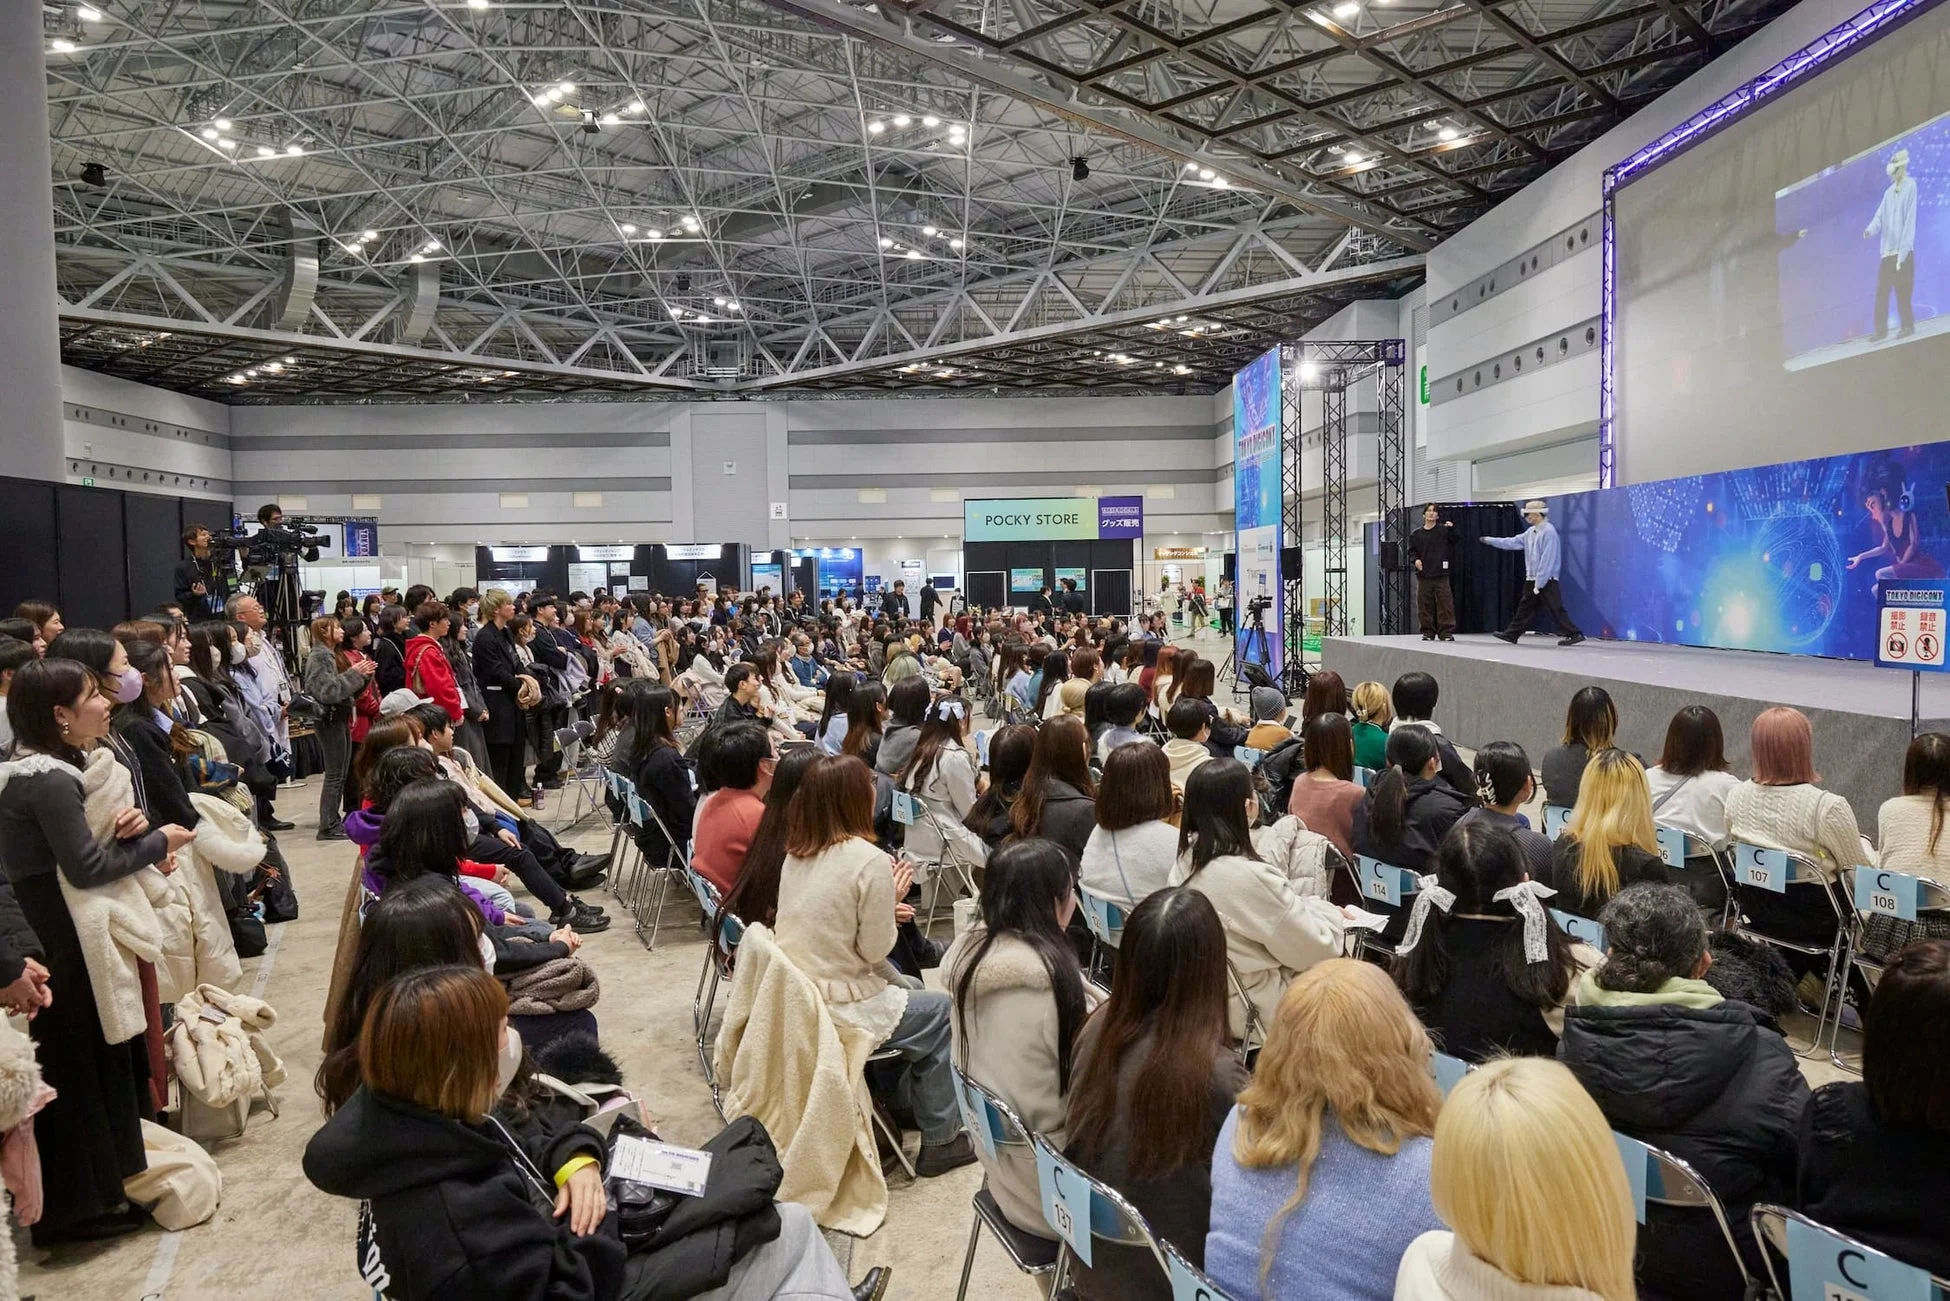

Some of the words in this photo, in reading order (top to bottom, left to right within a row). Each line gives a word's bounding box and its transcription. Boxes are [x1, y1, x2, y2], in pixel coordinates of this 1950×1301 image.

[985, 514, 1031, 526] POCKY
[1036, 513, 1079, 525] STORE
[1102, 519, 1139, 528] グッズ販売
[1887, 591, 1909, 600] TOKYO
[1910, 591, 1943, 601] DIGICONX
[1891, 611, 1906, 621] 撮影
[1920, 612, 1936, 622] 録音
[1890, 621, 1906, 631] 禁止
[1920, 622, 1936, 632] 禁止
[1656, 829, 1664, 843] C
[1754, 849, 1765, 866] C
[1374, 862, 1383, 879] C
[1750, 870, 1768, 882] 107
[1877, 873, 1890, 891] C
[1373, 883, 1386, 896] 114
[1873, 895, 1895, 910] 108
[1053, 1166, 1066, 1200] C
[1054, 1204, 1072, 1234] 137
[1837, 1249, 1868, 1290] C
